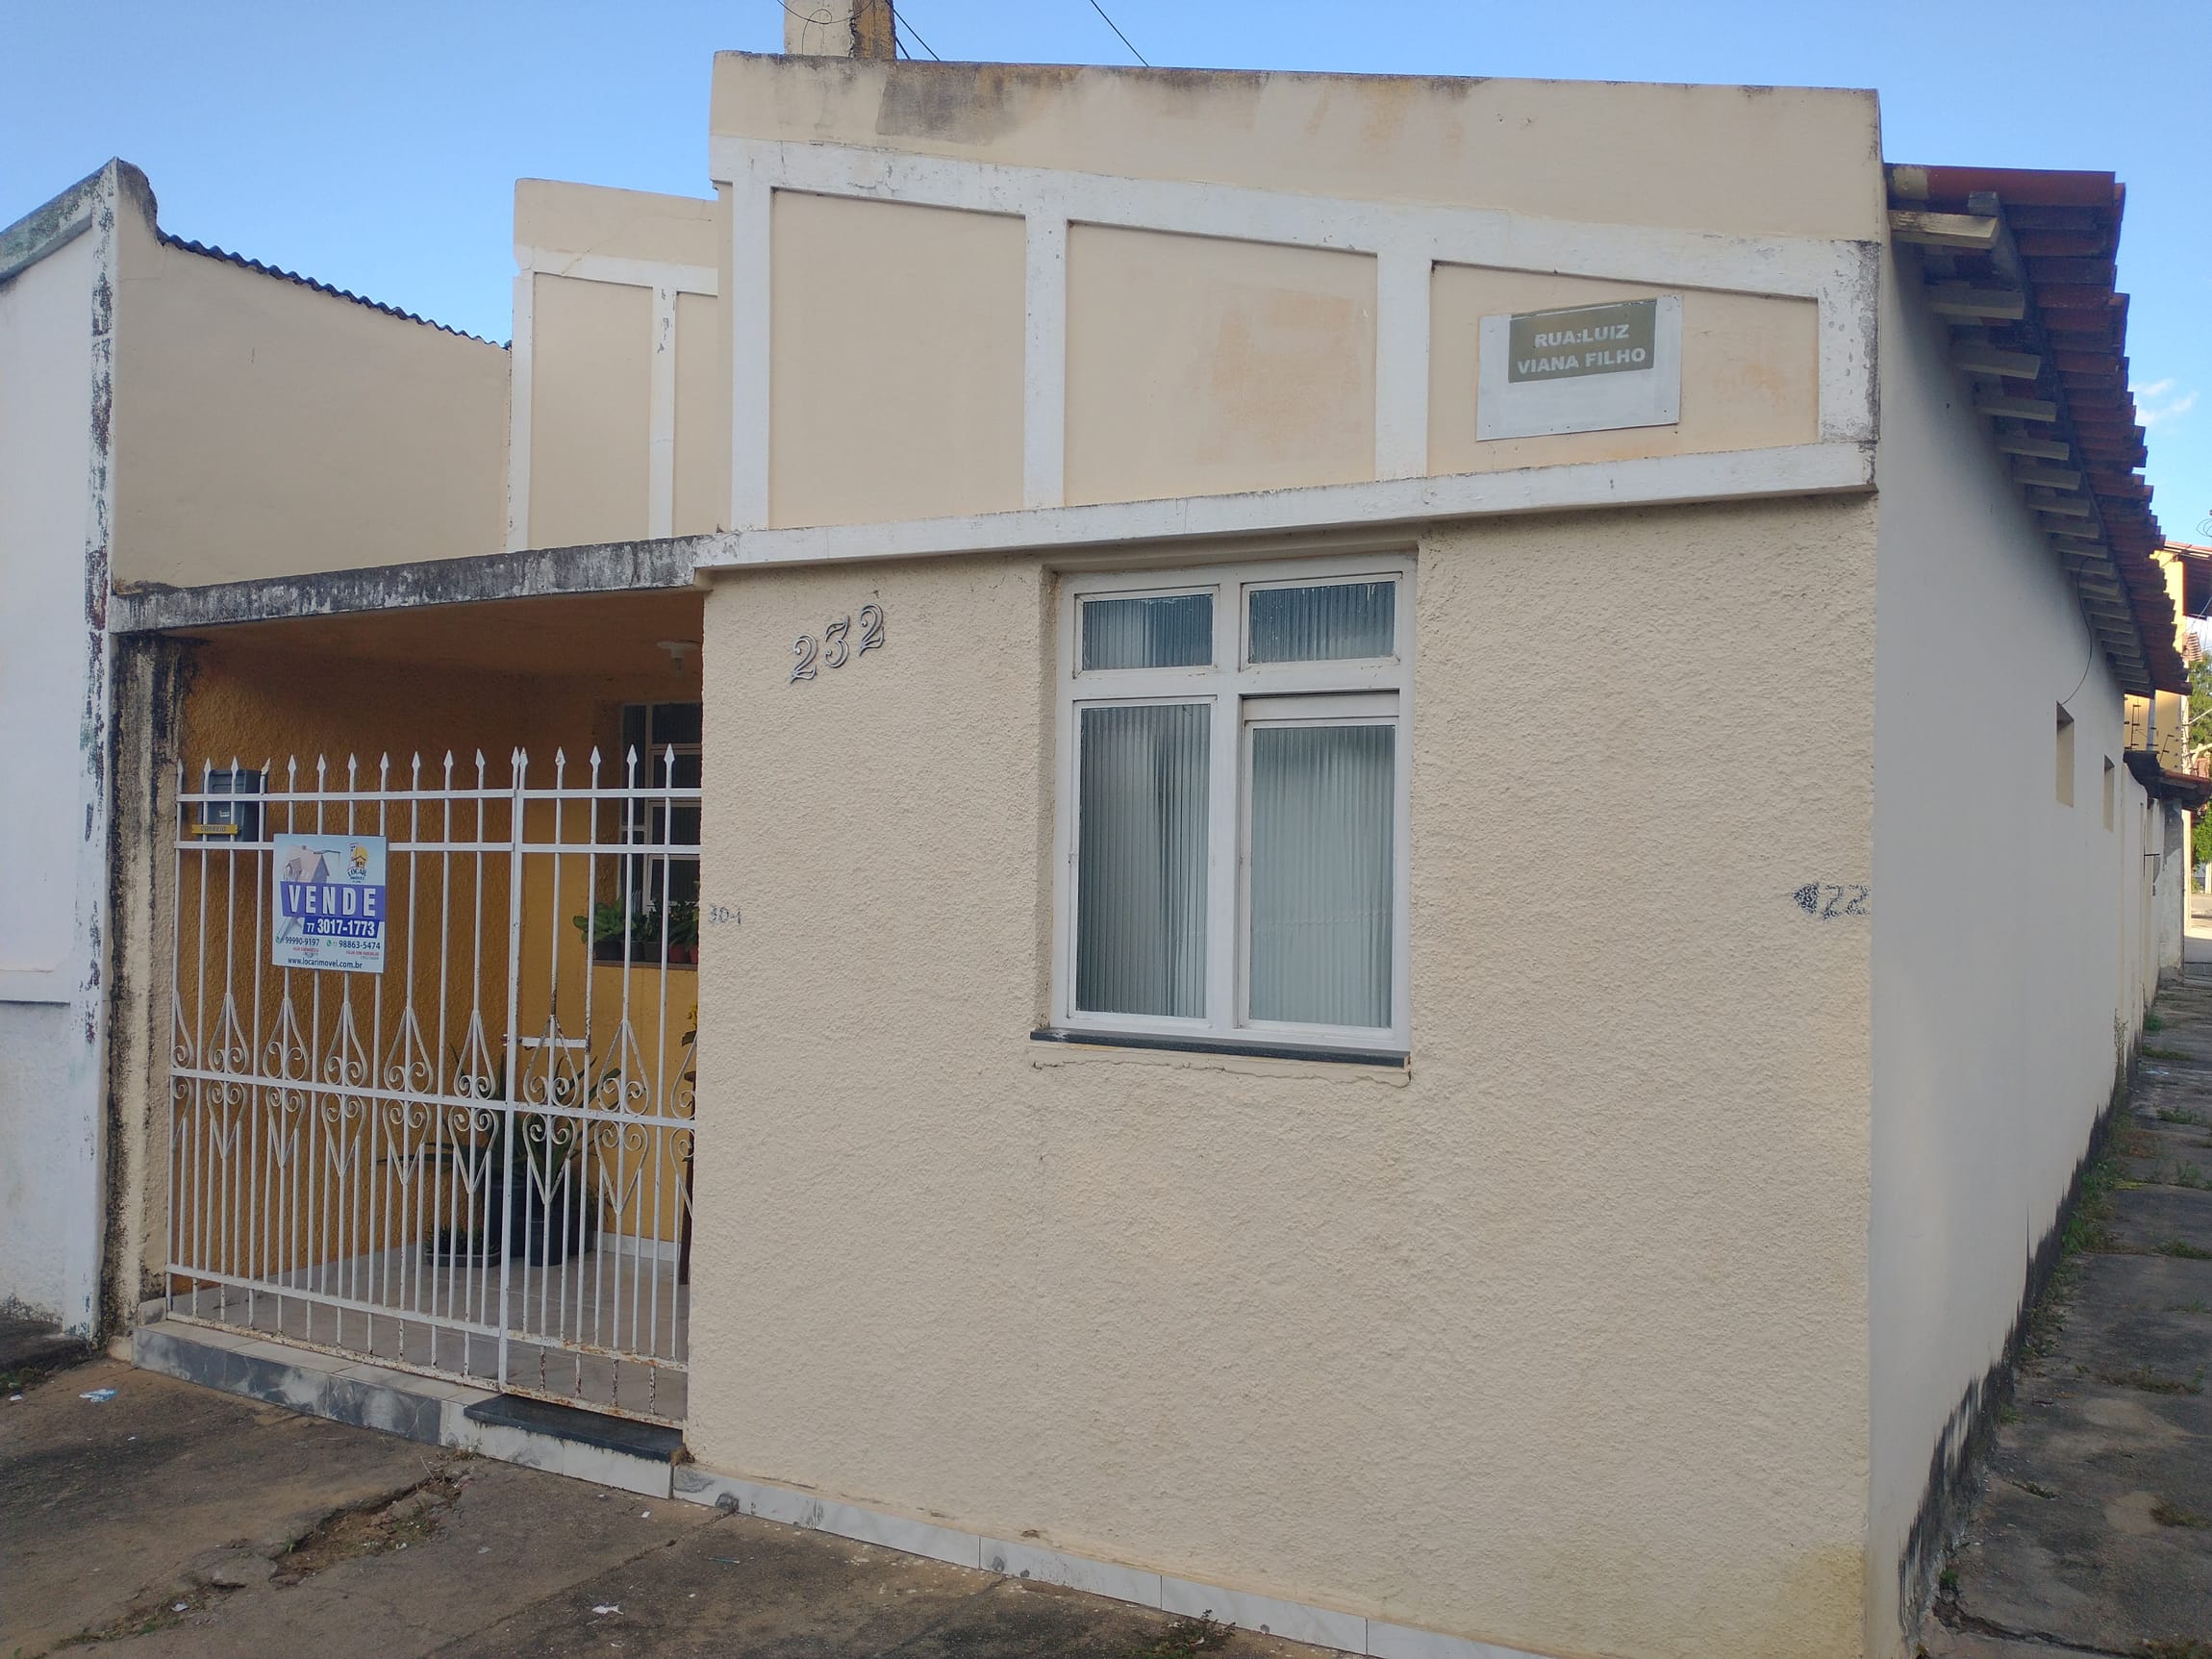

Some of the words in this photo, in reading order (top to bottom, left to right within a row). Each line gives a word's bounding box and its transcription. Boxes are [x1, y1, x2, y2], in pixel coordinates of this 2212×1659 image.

[1517, 355, 1579, 374] VIANA
[1585, 347, 1646, 367] FILHO
[790, 602, 885, 685] 232
[289, 884, 377, 917] VENDE
[307, 922, 315, 933] 77
[316, 917, 376, 937] 3017-1773
[285, 936, 320, 946] 99990-9197
[339, 940, 381, 950] 98863-5474
[288, 957, 363, 969] www.locarimovel.com.br
